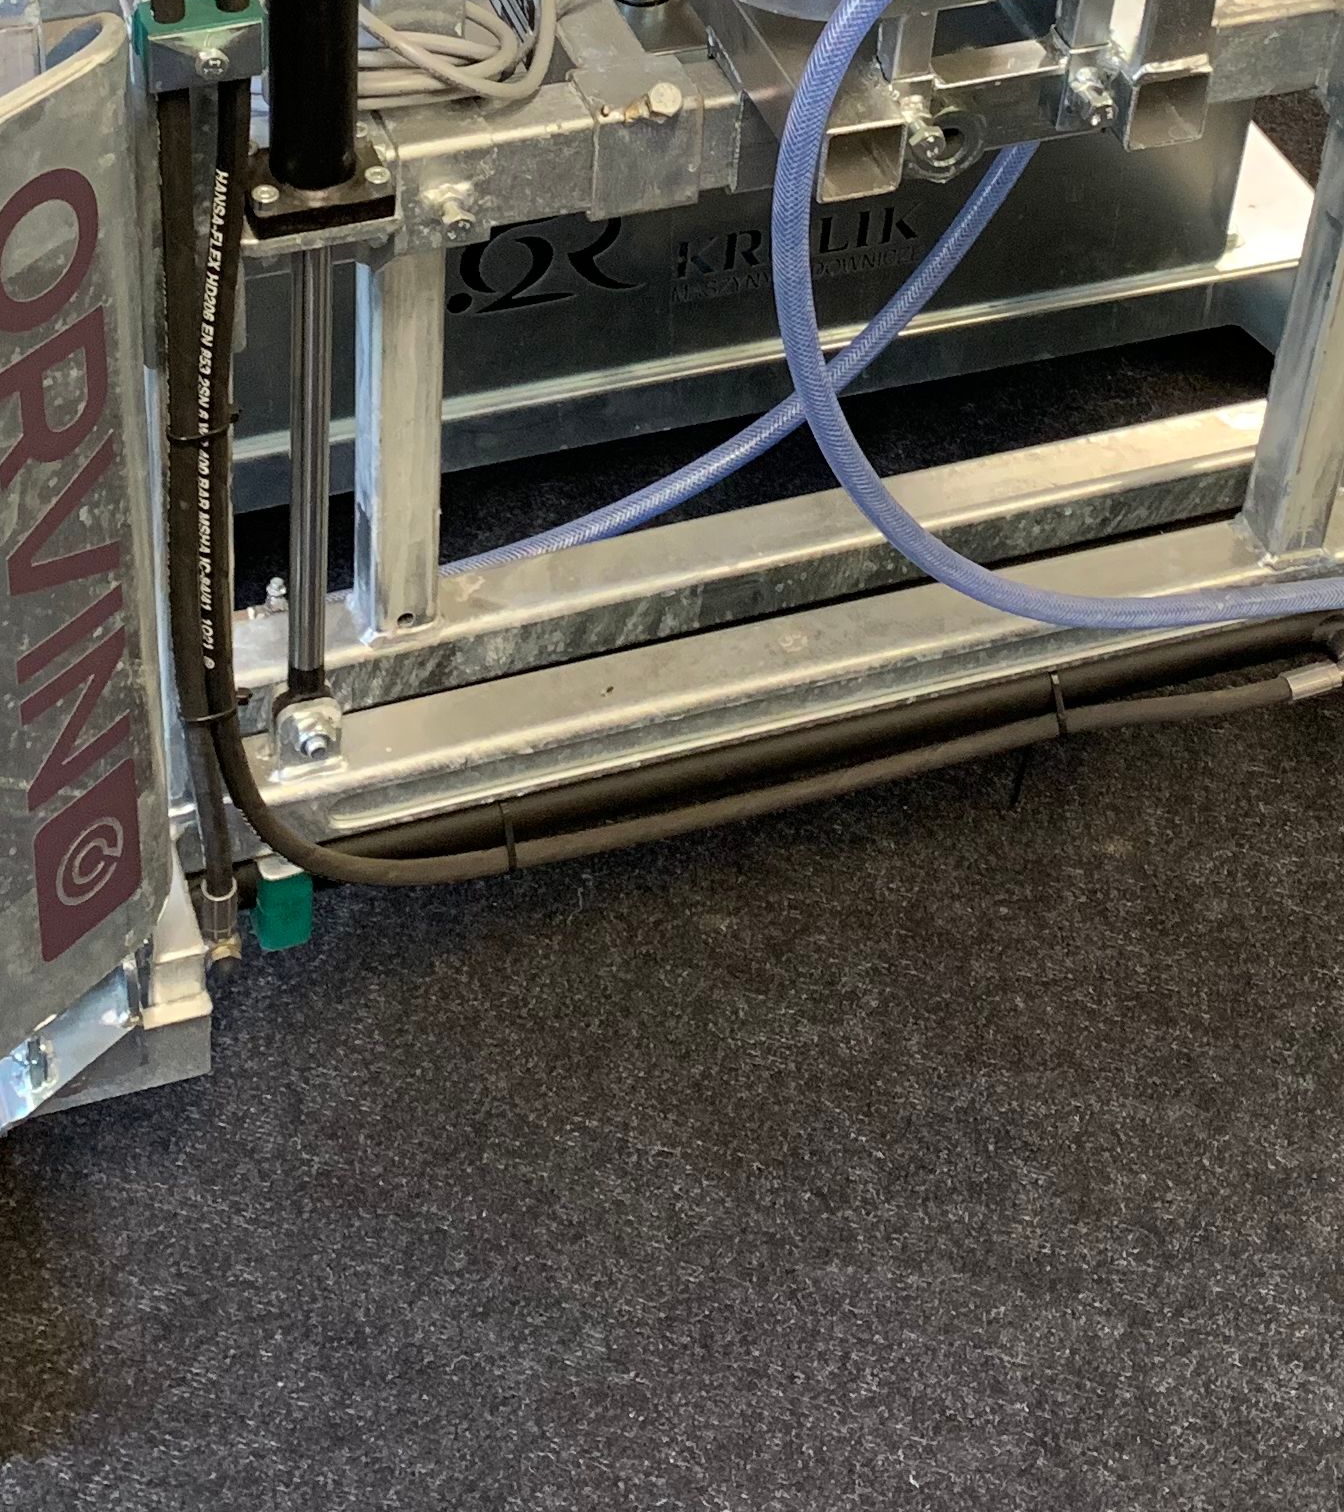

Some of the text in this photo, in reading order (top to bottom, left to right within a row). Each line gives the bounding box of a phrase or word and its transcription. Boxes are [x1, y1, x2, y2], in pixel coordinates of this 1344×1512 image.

[206, 167, 229, 272] HANSA-FLEX
[675, 203, 922, 280] KRLIK
[201, 270, 221, 323] HD206
[199, 323, 215, 348] EN
[197, 478, 212, 510] BAR
[197, 509, 212, 555] MSHA
